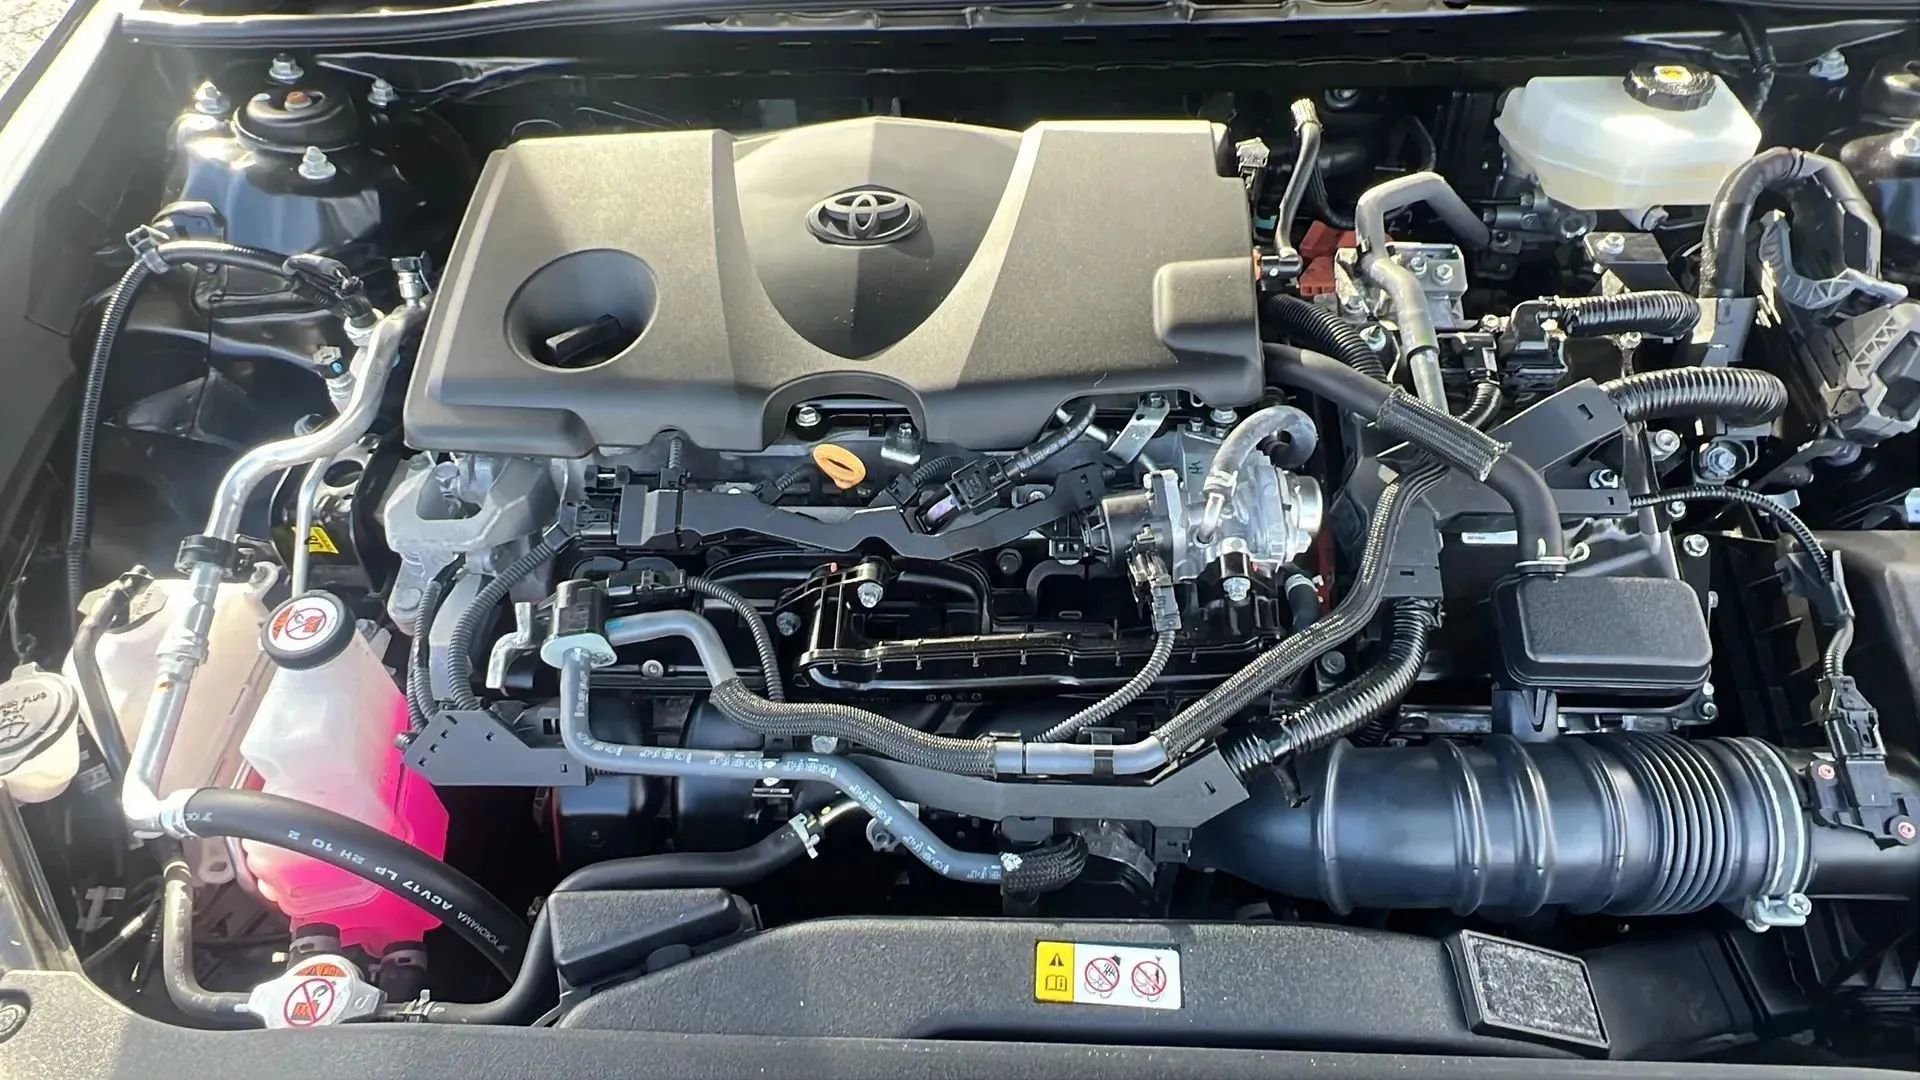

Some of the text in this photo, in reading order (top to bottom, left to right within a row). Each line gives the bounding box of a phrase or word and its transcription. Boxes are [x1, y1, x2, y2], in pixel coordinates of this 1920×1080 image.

[374, 866, 398, 881] LP
[402, 880, 453, 911] ACV17
[457, 911, 500, 948] YOKOHAMA
